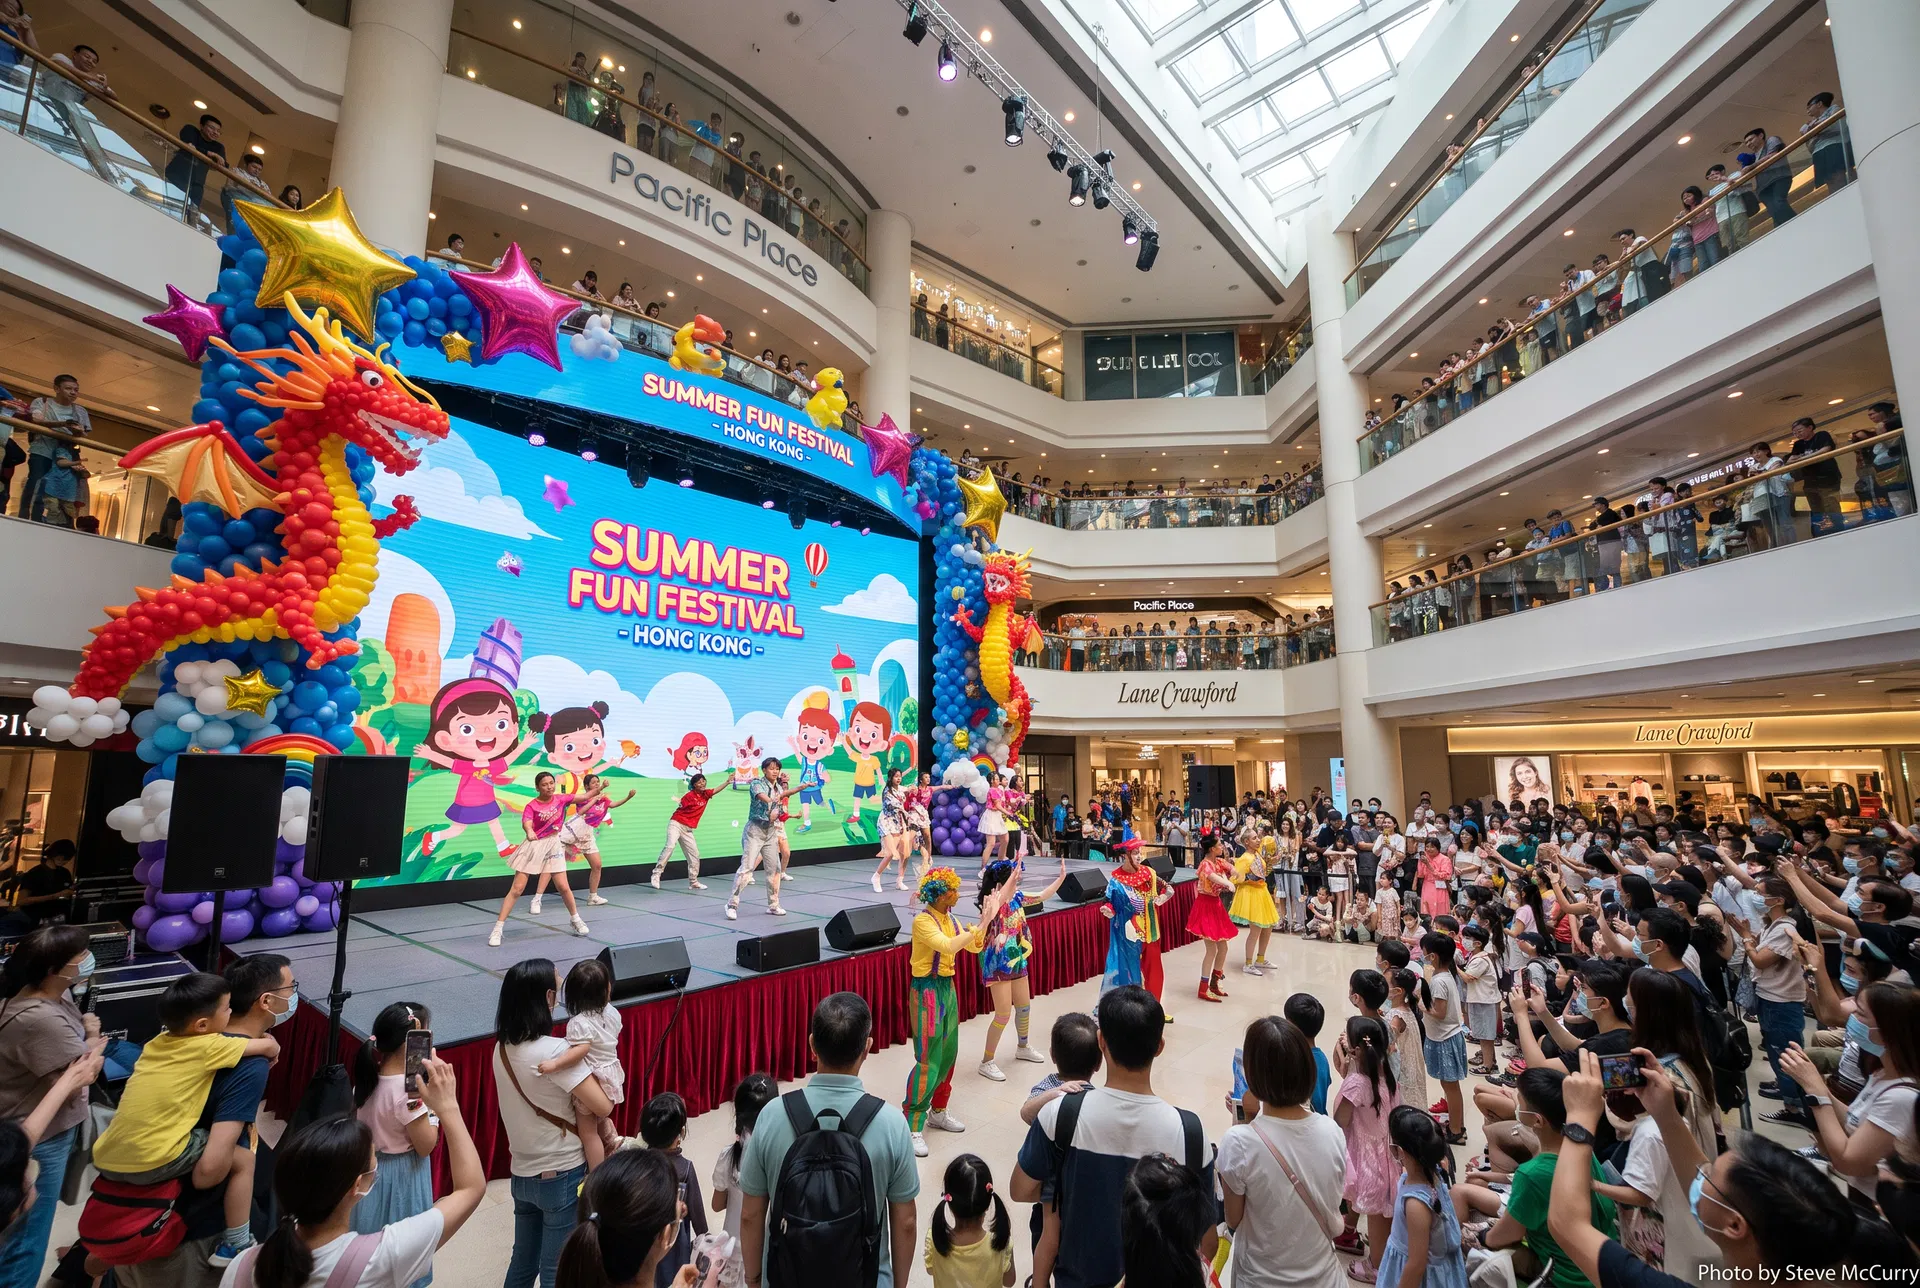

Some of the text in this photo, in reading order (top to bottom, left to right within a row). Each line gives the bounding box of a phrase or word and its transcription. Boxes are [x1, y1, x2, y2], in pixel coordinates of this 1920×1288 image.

[611, 152, 818, 287] Pacific Place
[643, 373, 854, 467] SUMMER FUN FESTIVAL
[723, 422, 765, 447] HONG
[768, 437, 803, 461] KONG
[568, 518, 804, 638] SUMMER FUN FESTIVAL
[1133, 600, 1194, 610] Pacific Place
[633, 624, 694, 649] HONG
[699, 633, 752, 656] KONG
[1118, 681, 1238, 709] Lane Crawford
[1635, 722, 1753, 745] Lane Crawford
